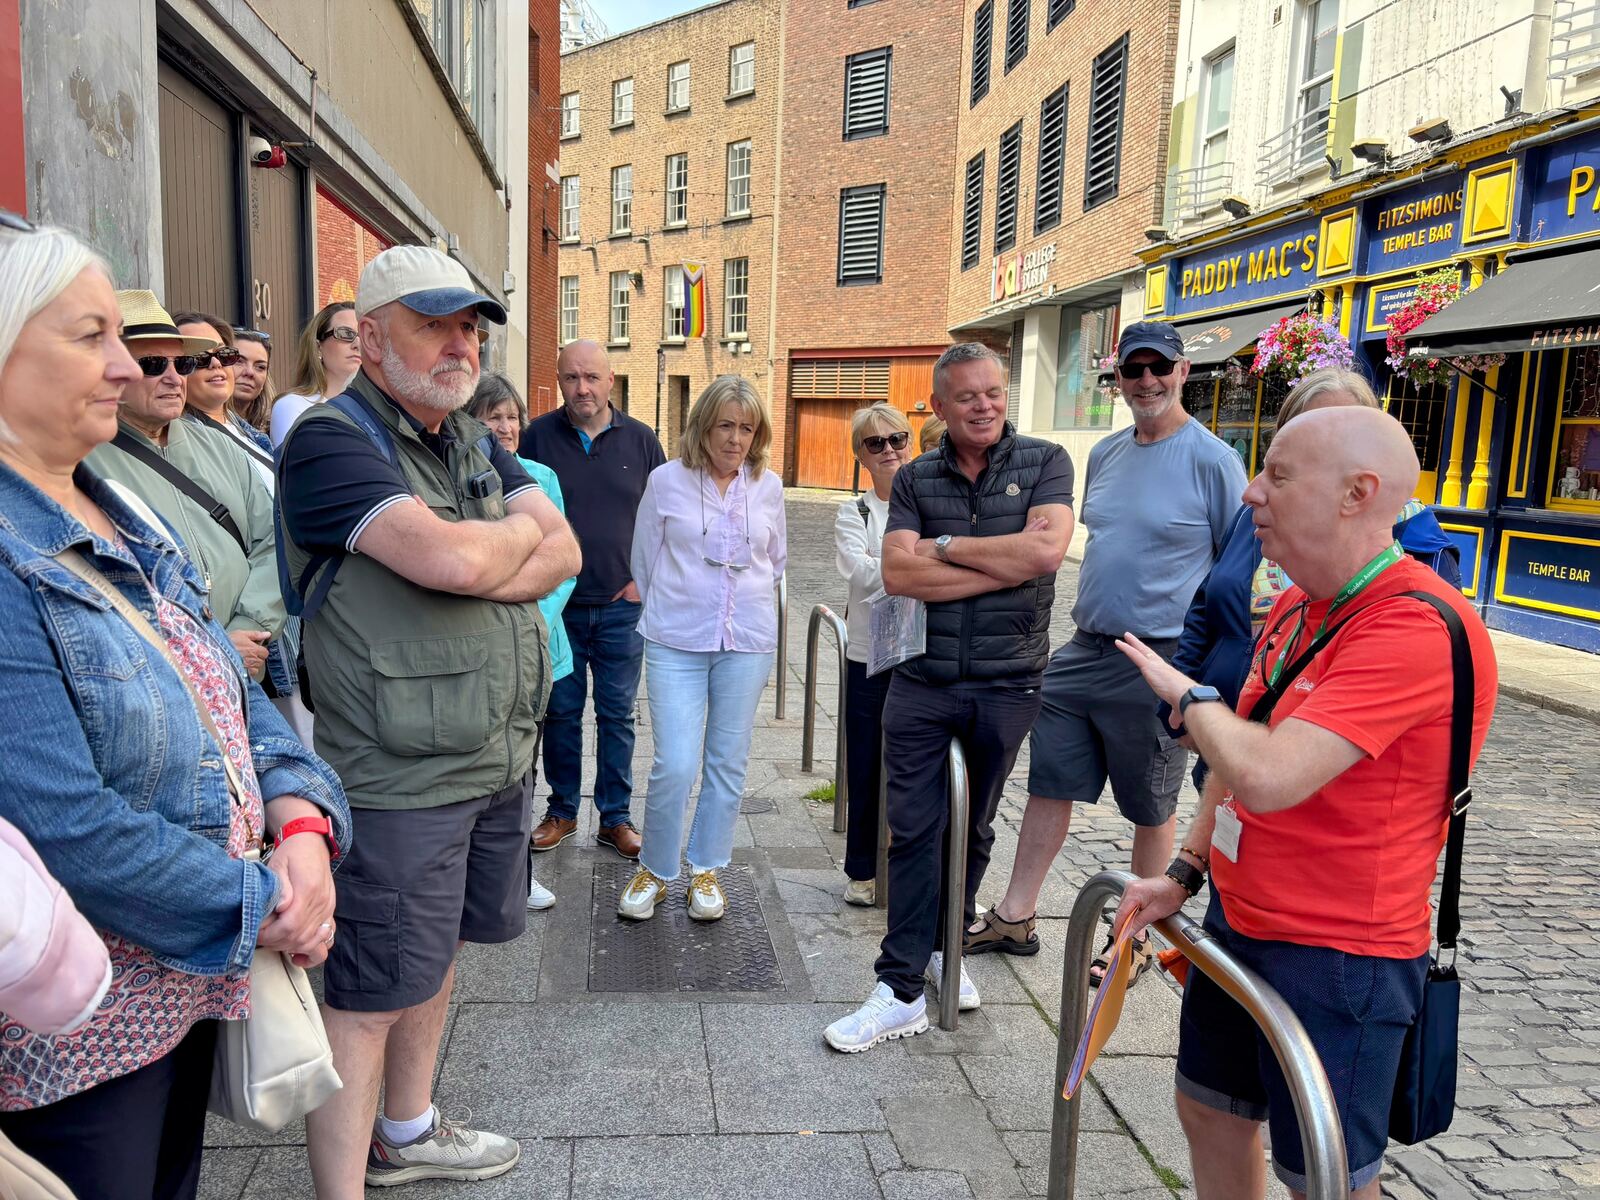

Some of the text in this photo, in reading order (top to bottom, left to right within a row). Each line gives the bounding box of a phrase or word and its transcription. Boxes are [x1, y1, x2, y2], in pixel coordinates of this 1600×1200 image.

[1377, 189, 1463, 231] FITZSIMONS
[1024, 241, 1057, 271] COLLEGE
[1383, 222, 1453, 254] TEMPLE BAR
[991, 250, 1024, 302] ibat
[1023, 262, 1048, 291] DUBLIN
[1181, 234, 1317, 300] PADDY MAC'S
[254, 279, 271, 320] 30
[1347, 579, 1365, 595] Guides
[1363, 557, 1390, 580] Association
[1528, 561, 1591, 583] TEMPLE BAR
